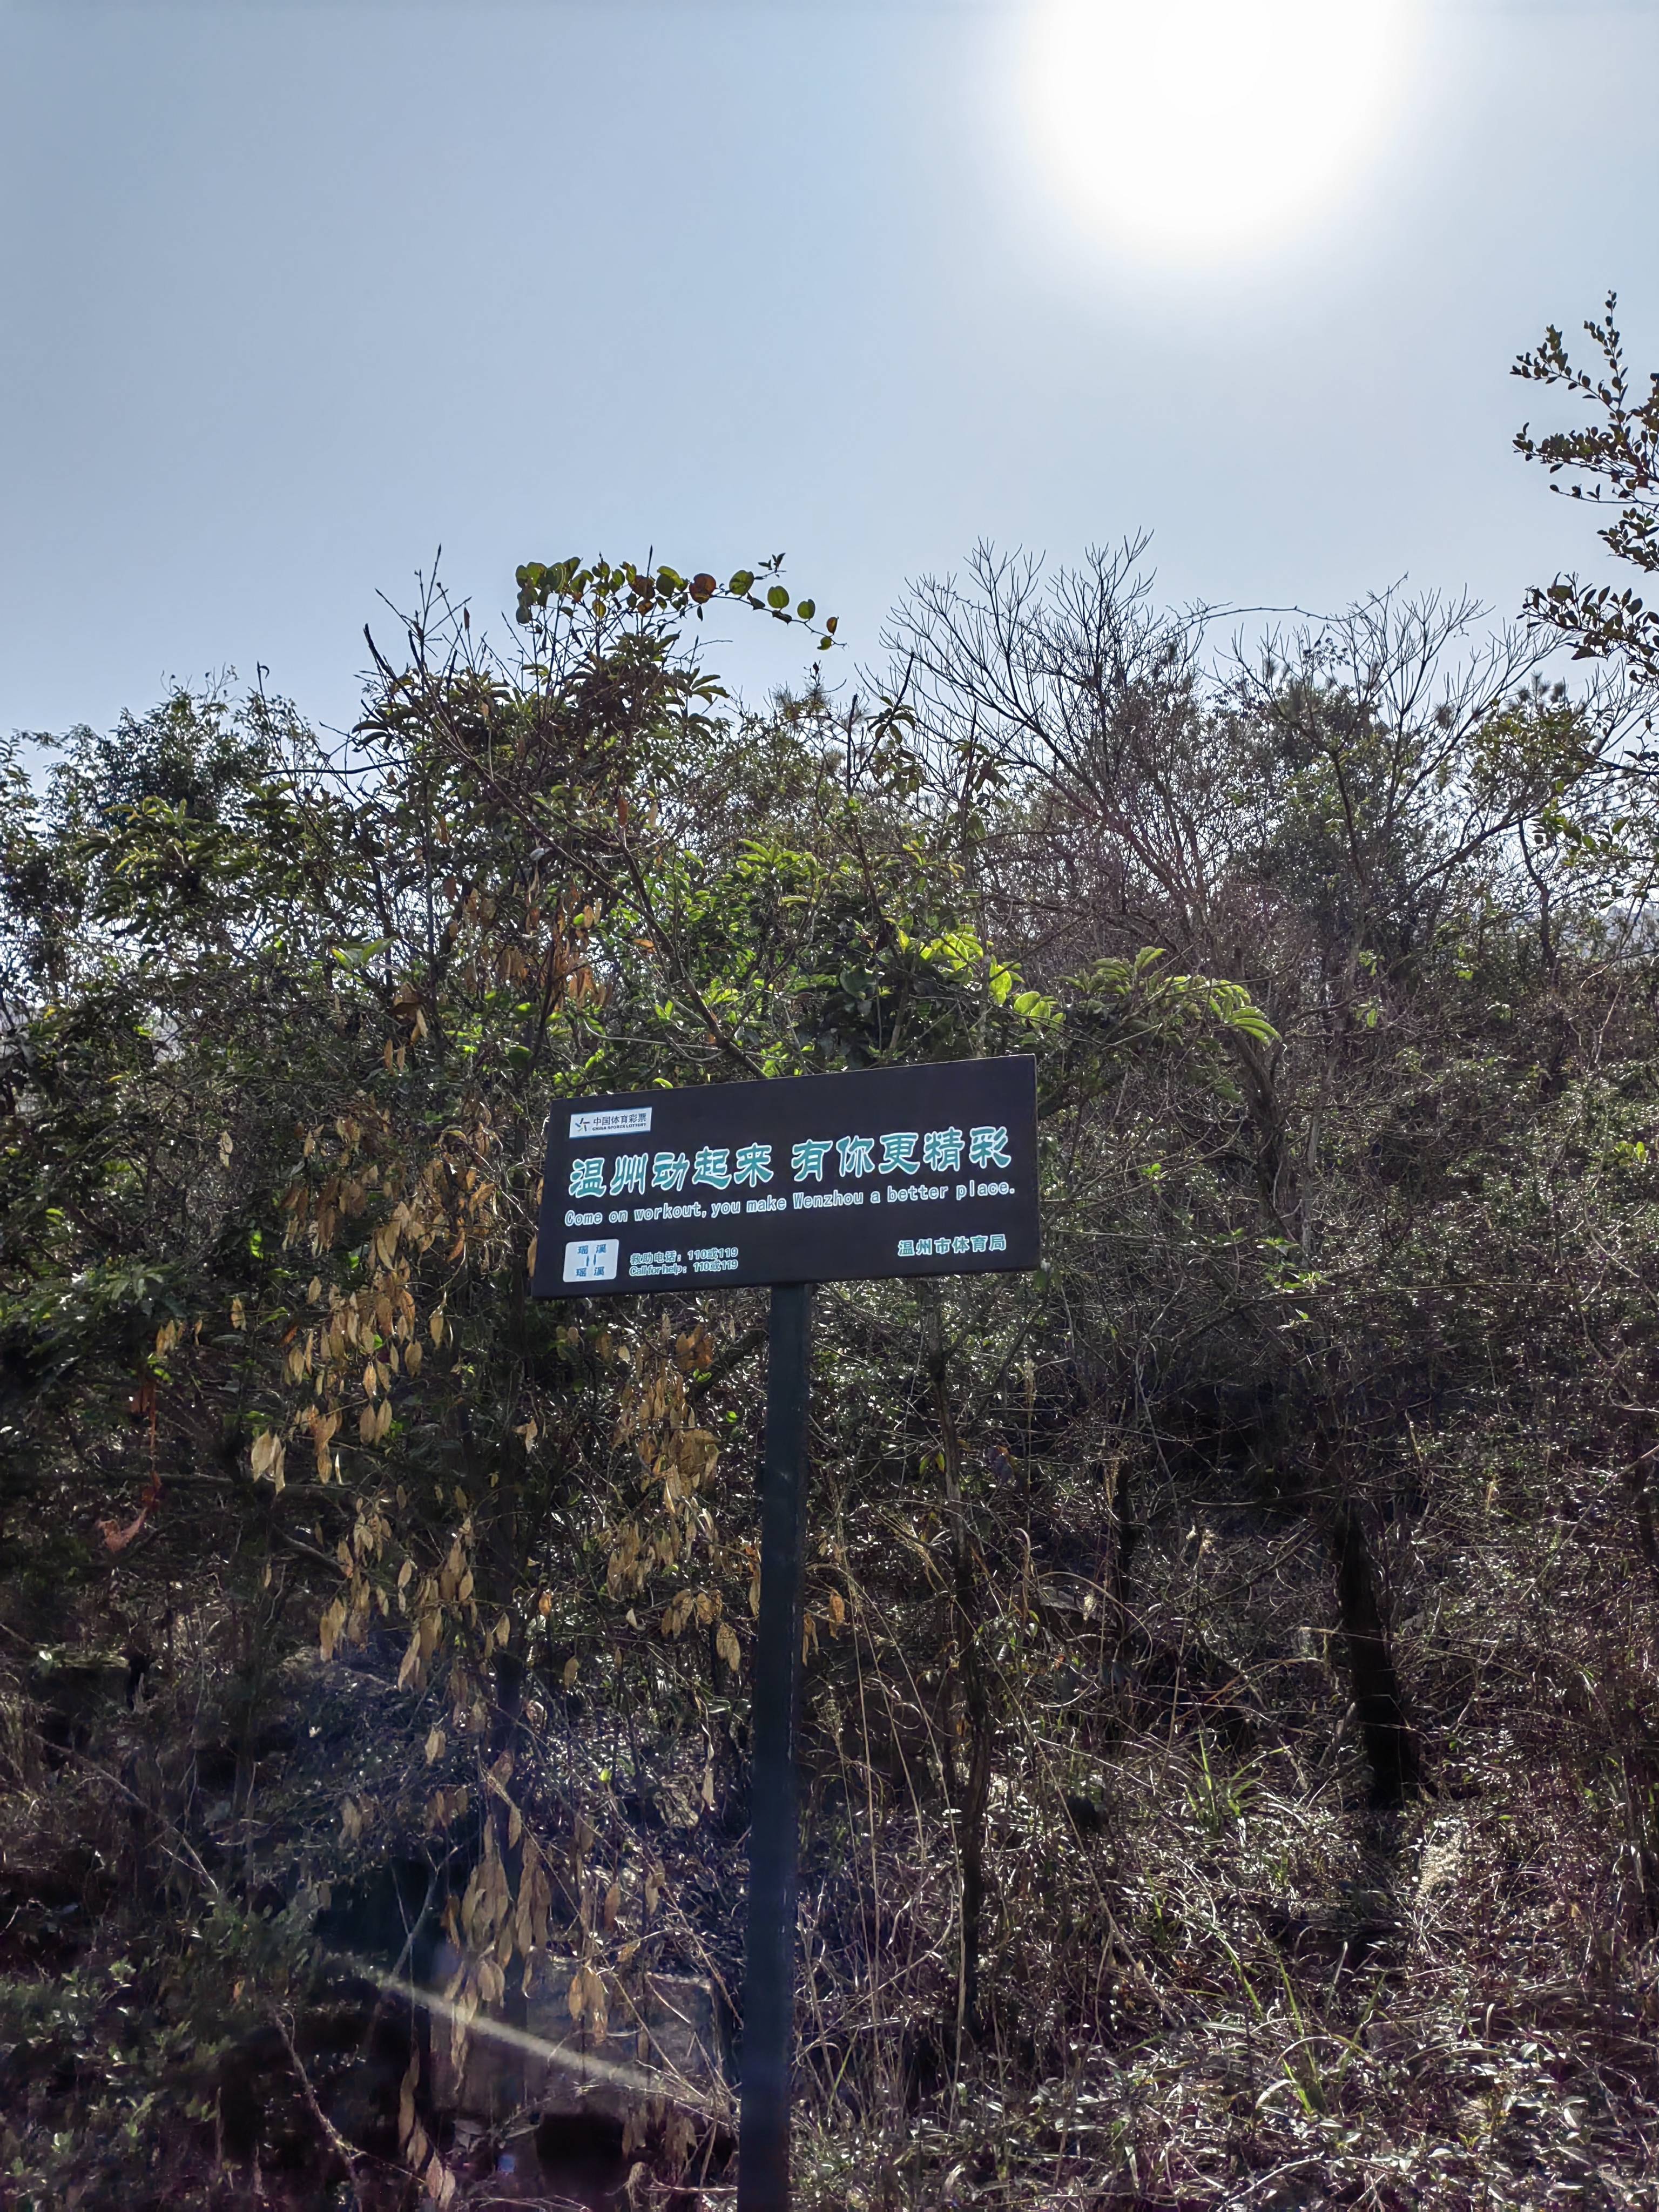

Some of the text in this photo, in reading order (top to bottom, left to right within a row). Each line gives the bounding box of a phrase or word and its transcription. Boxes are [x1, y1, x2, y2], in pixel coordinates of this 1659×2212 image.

[594, 1113, 647, 1126] 中国体育彩票
[568, 1126, 1012, 1198] 温州动起来 有你更精彩
[564, 1179, 1015, 1226] Come on workout, you make Wenzhou a better place.
[687, 1247, 739, 1261] 110或119
[898, 1234, 1007, 1257] 温州市体育局
[629, 1265, 646, 1276] Call
[647, 1265, 662, 1275] for
[693, 1259, 739, 1272] 110或119
